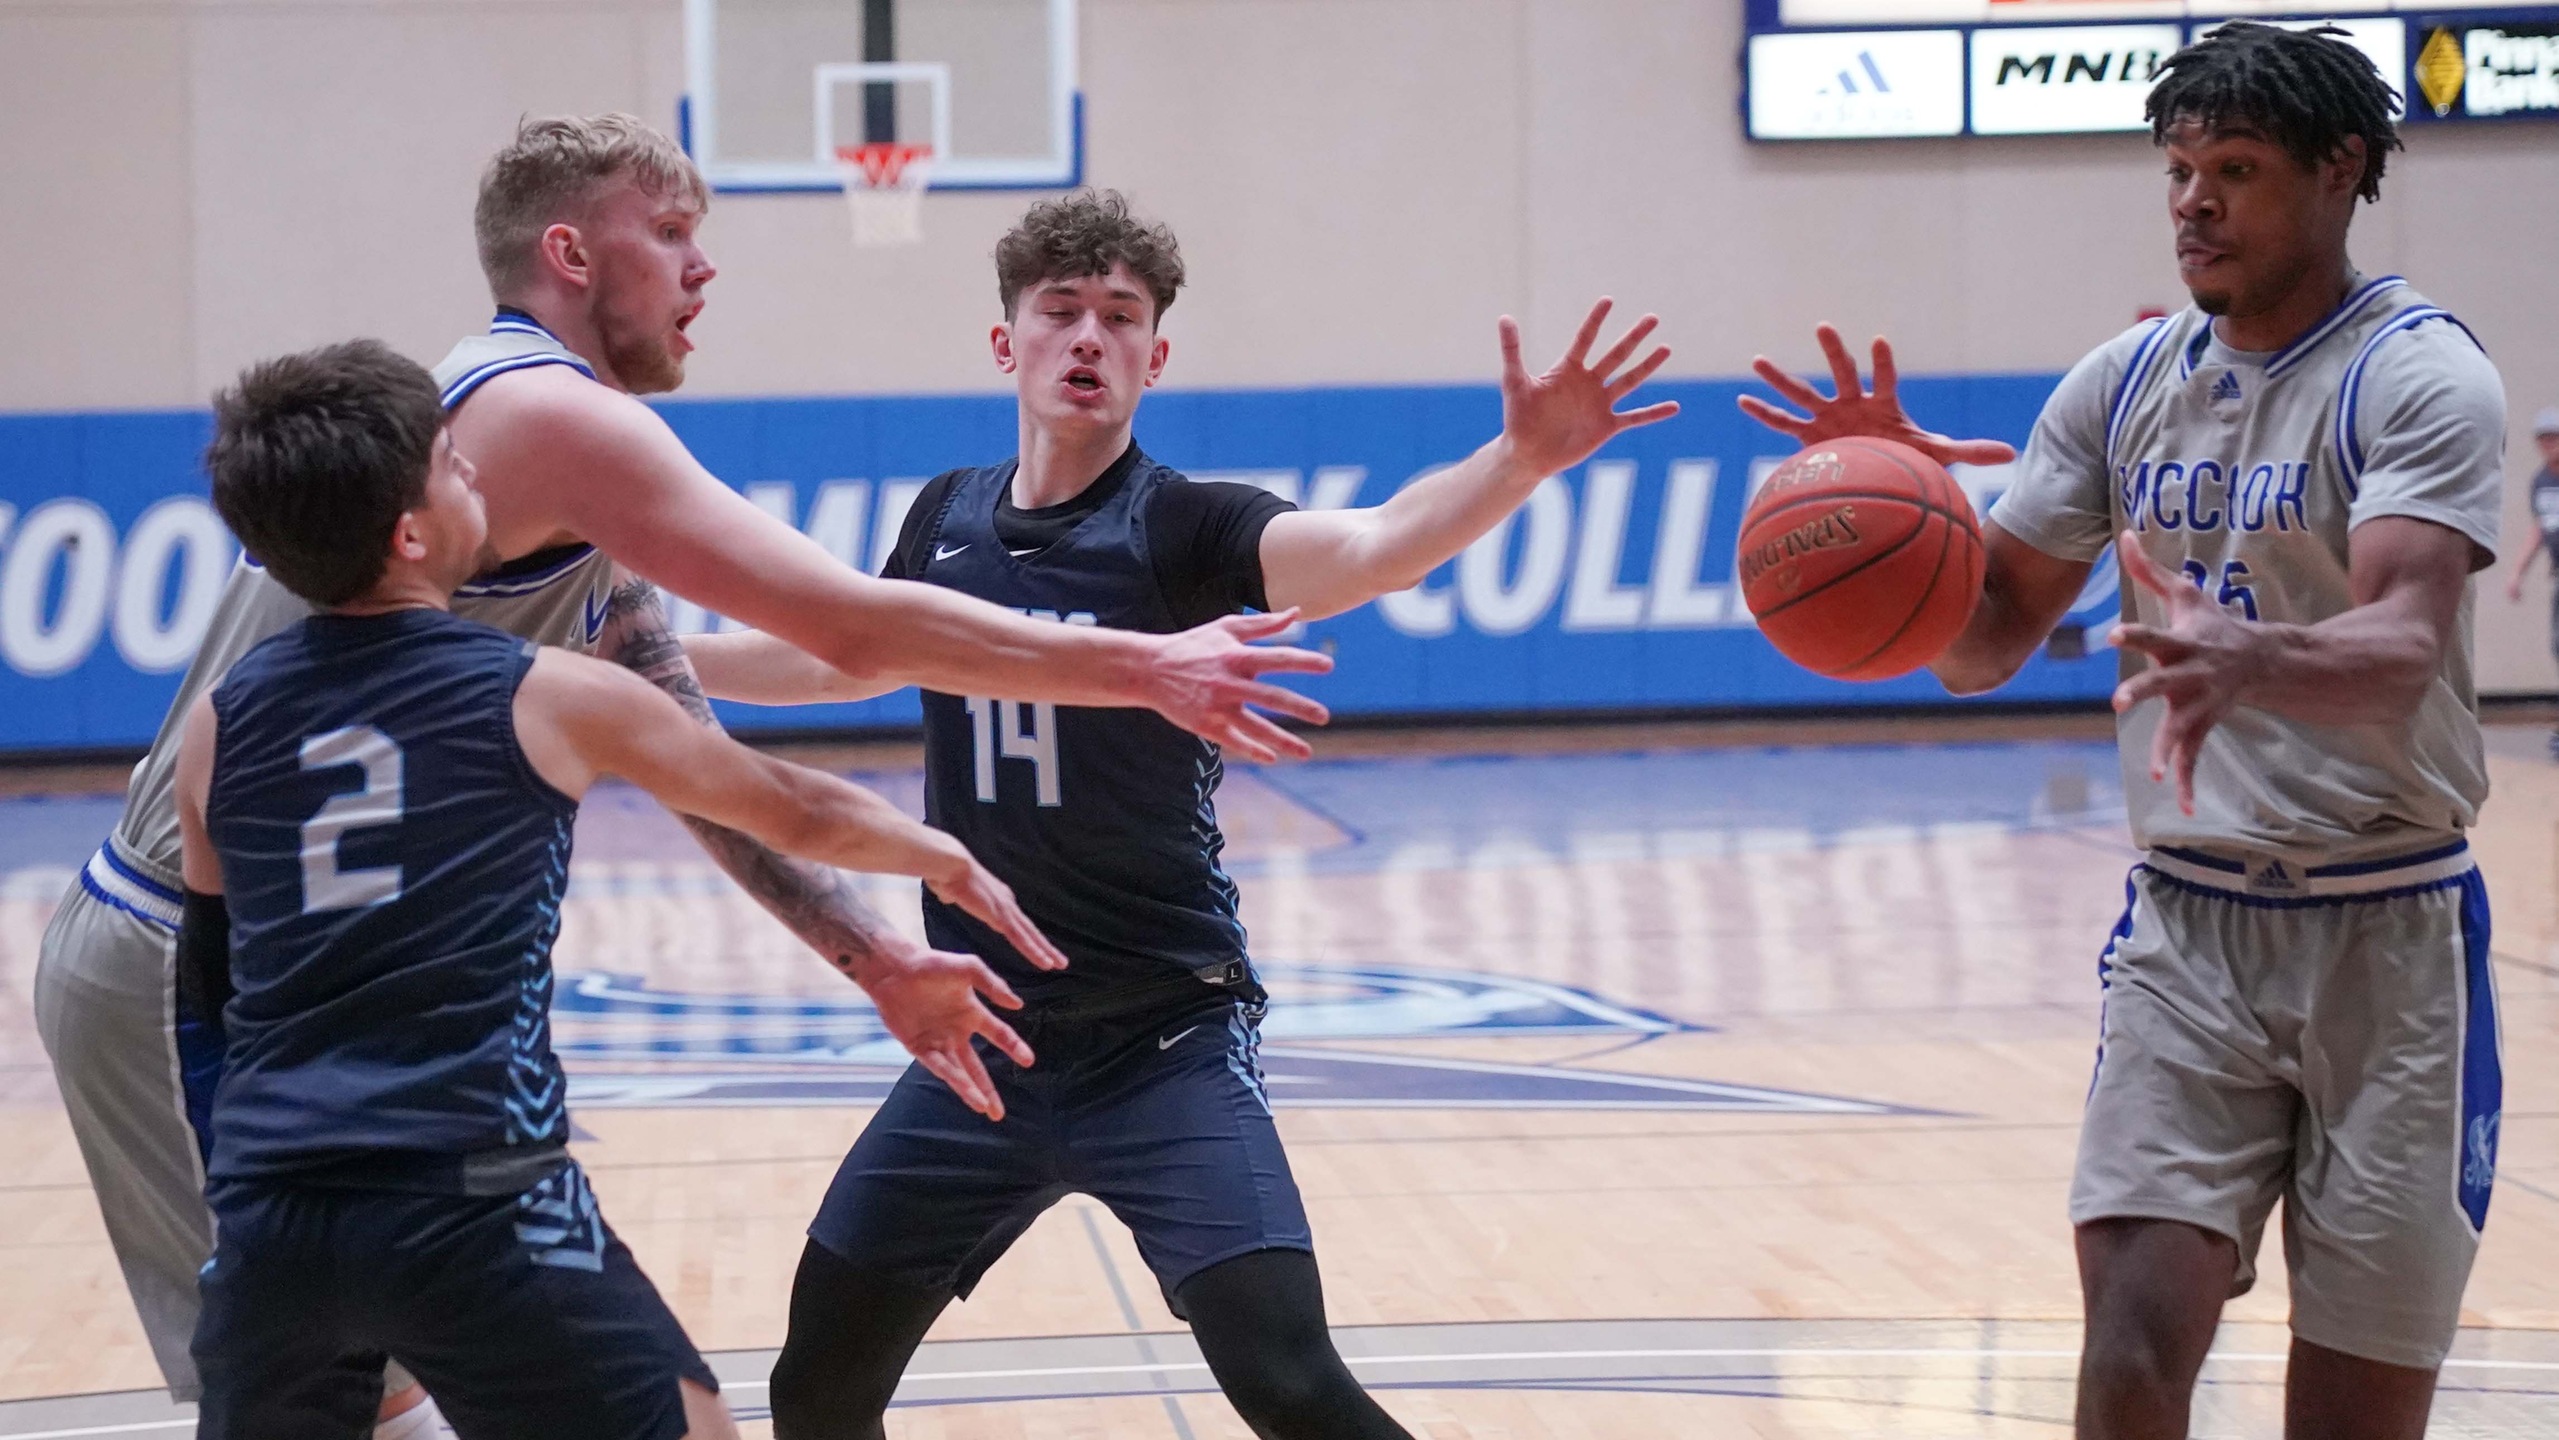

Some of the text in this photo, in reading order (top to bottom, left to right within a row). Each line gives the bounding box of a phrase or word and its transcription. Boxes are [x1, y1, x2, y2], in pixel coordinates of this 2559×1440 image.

[0, 495, 230, 677] OO
[1739, 505, 1859, 583] SPALDIN
[964, 696, 1062, 808] 14
[299, 725, 404, 915] 2
[1230, 968, 1238, 978] L
